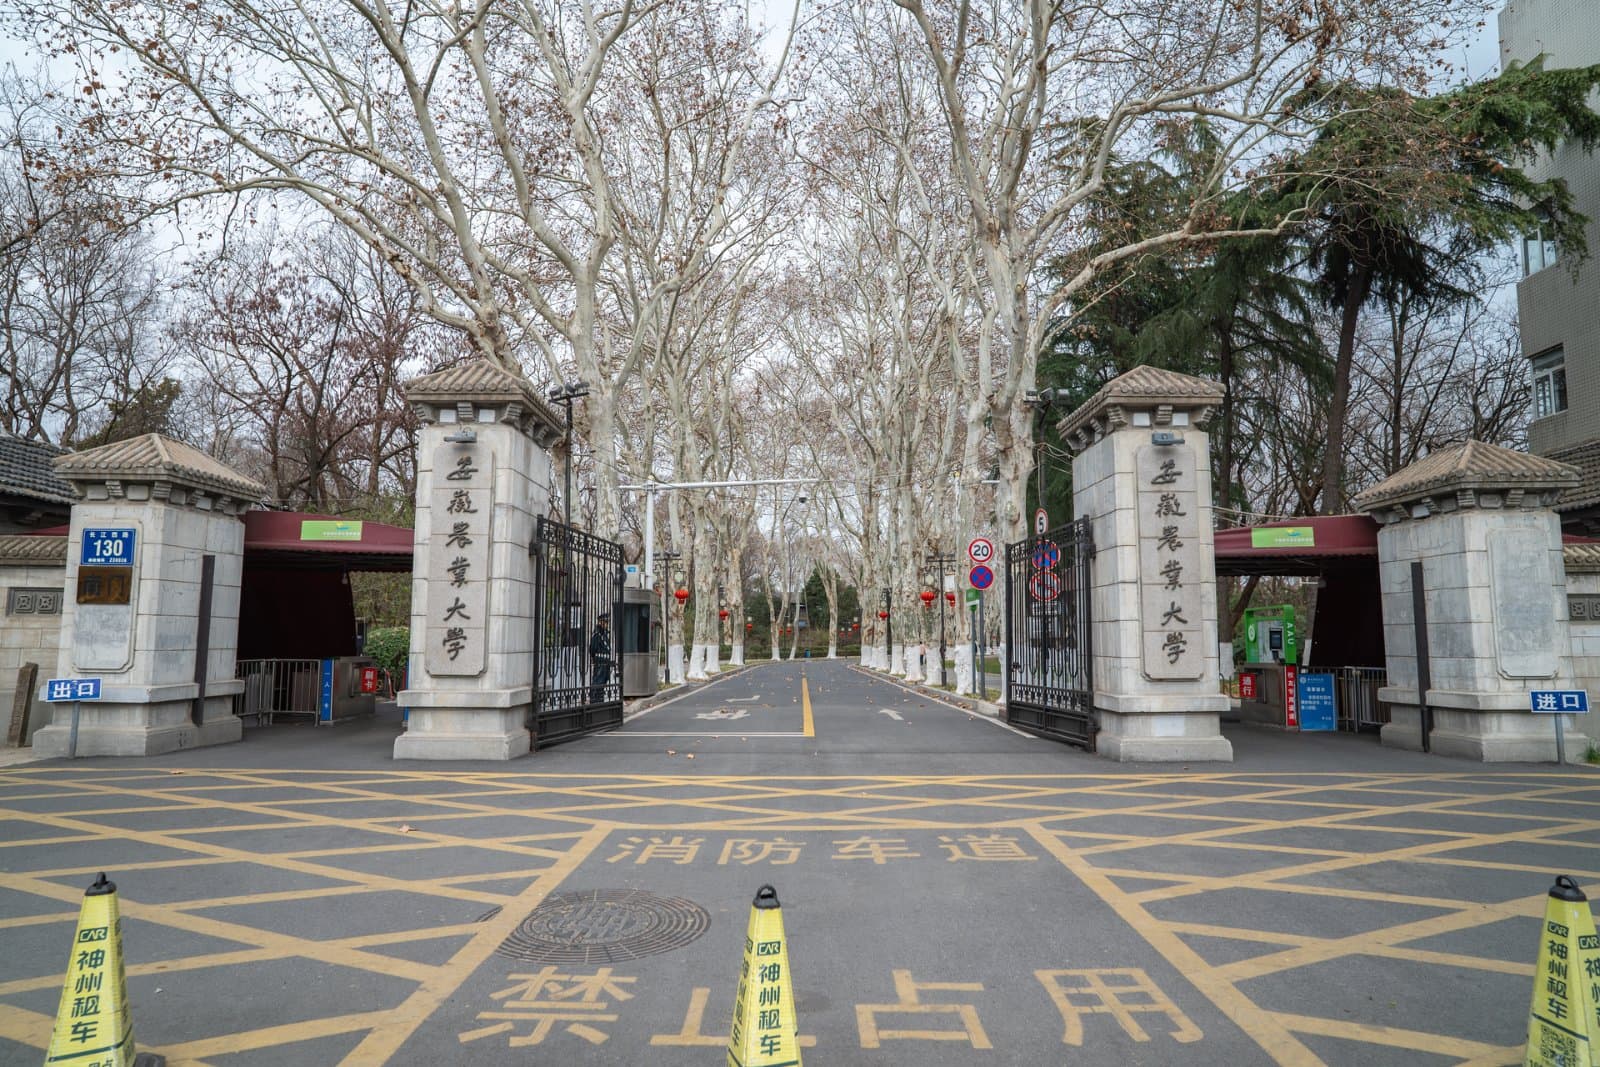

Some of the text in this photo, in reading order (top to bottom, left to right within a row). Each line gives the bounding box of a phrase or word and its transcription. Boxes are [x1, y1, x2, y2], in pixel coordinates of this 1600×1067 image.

[1038, 516, 1044, 533] 5
[93, 539, 123, 557] 130
[973, 544, 989, 557] 20
[1286, 622, 1295, 645] AAU
[53, 682, 94, 698] 出口
[1536, 693, 1580, 710] 进口
[605, 835, 1038, 865] 消防车道
[79, 929, 106, 941] CAR
[758, 943, 780, 955] CAR
[1547, 939, 1569, 1020] 神州租车
[70, 948, 105, 1043] 神州租车
[758, 962, 781, 1056] 神州租车
